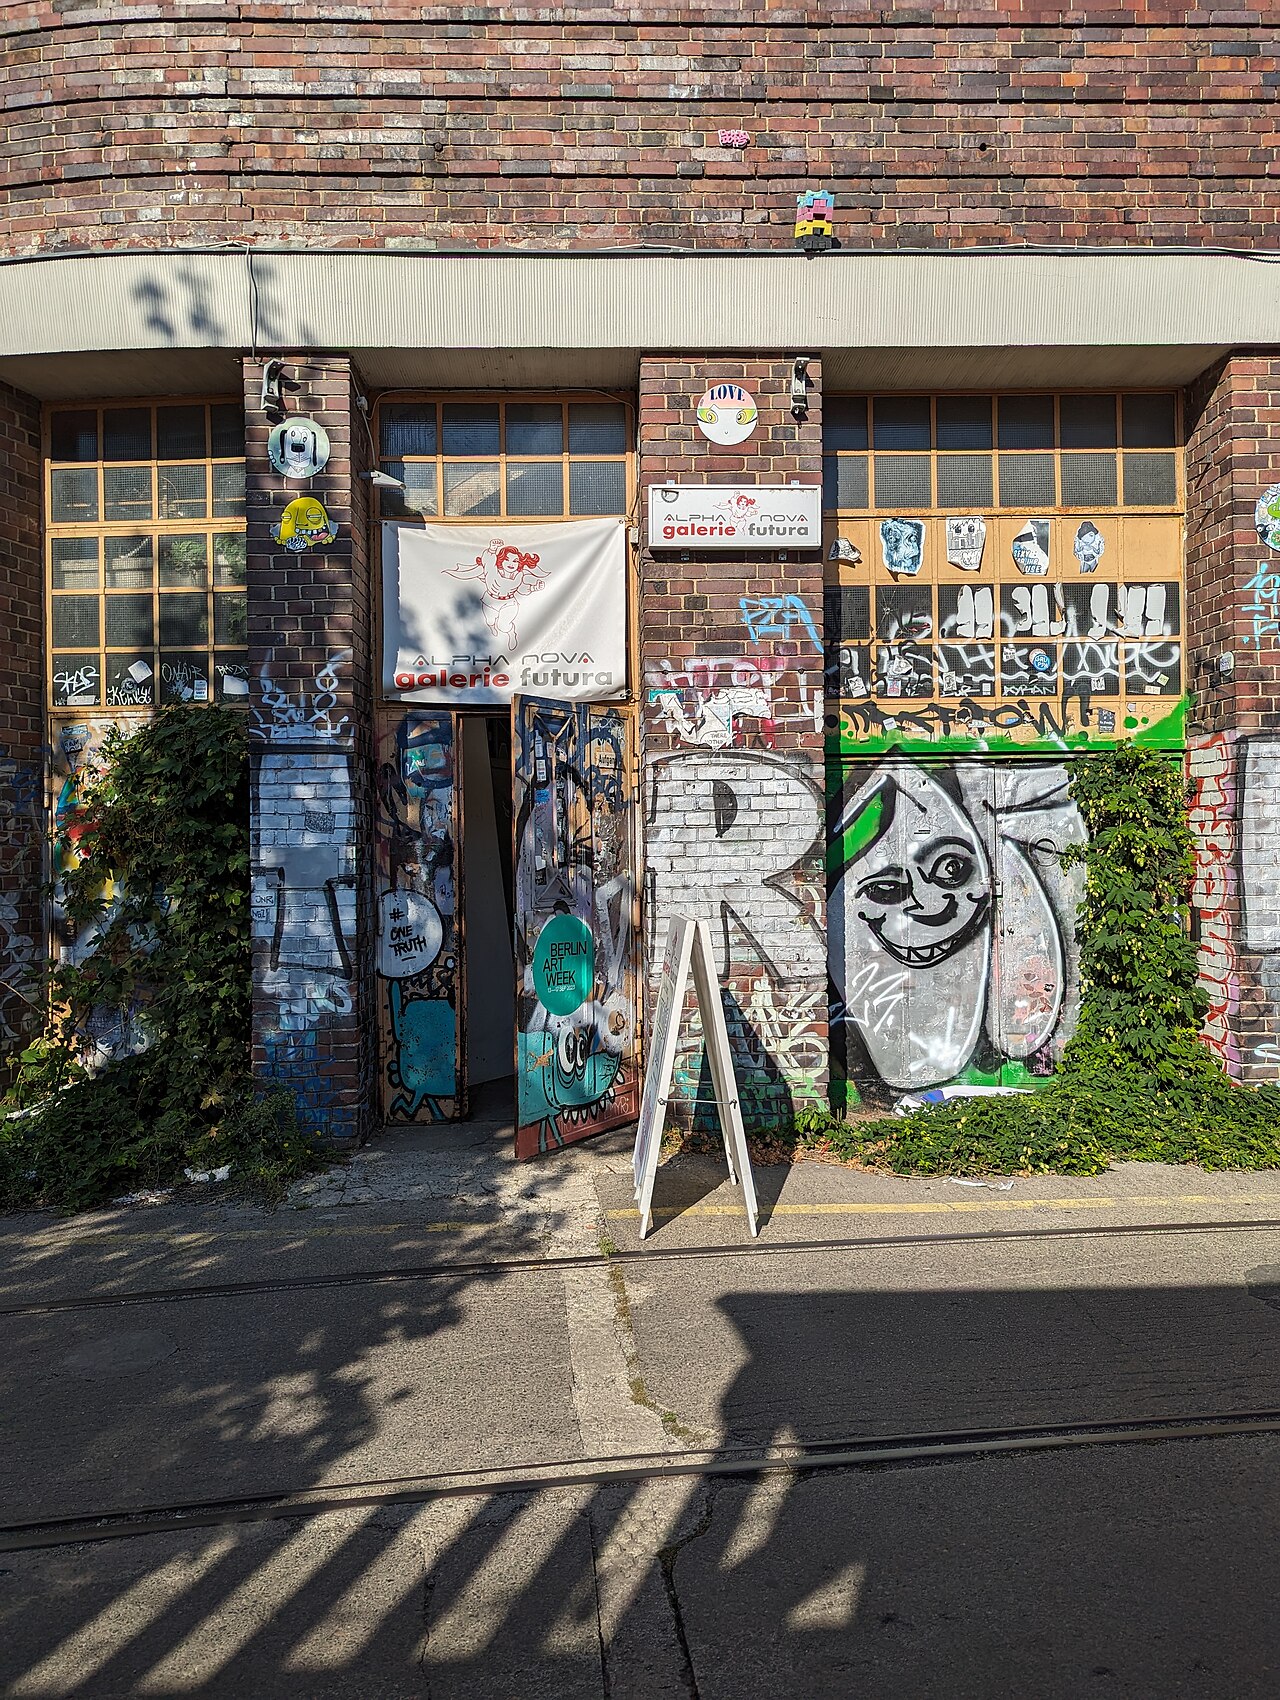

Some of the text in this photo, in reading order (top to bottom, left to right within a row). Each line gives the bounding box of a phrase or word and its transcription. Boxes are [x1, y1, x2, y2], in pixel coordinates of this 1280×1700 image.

[710, 385, 745, 402] LOVE
[664, 514, 727, 522] ALPHA
[663, 521, 809, 539] galerie futura
[412, 655, 510, 665] ALPHA
[395, 667, 613, 690] galerie futura
[391, 925, 413, 941] ONE
[389, 935, 427, 956] TRUTH
[550, 941, 587, 957] BERLIN
[543, 957, 565, 972] ART
[546, 970, 575, 986] WEEK
